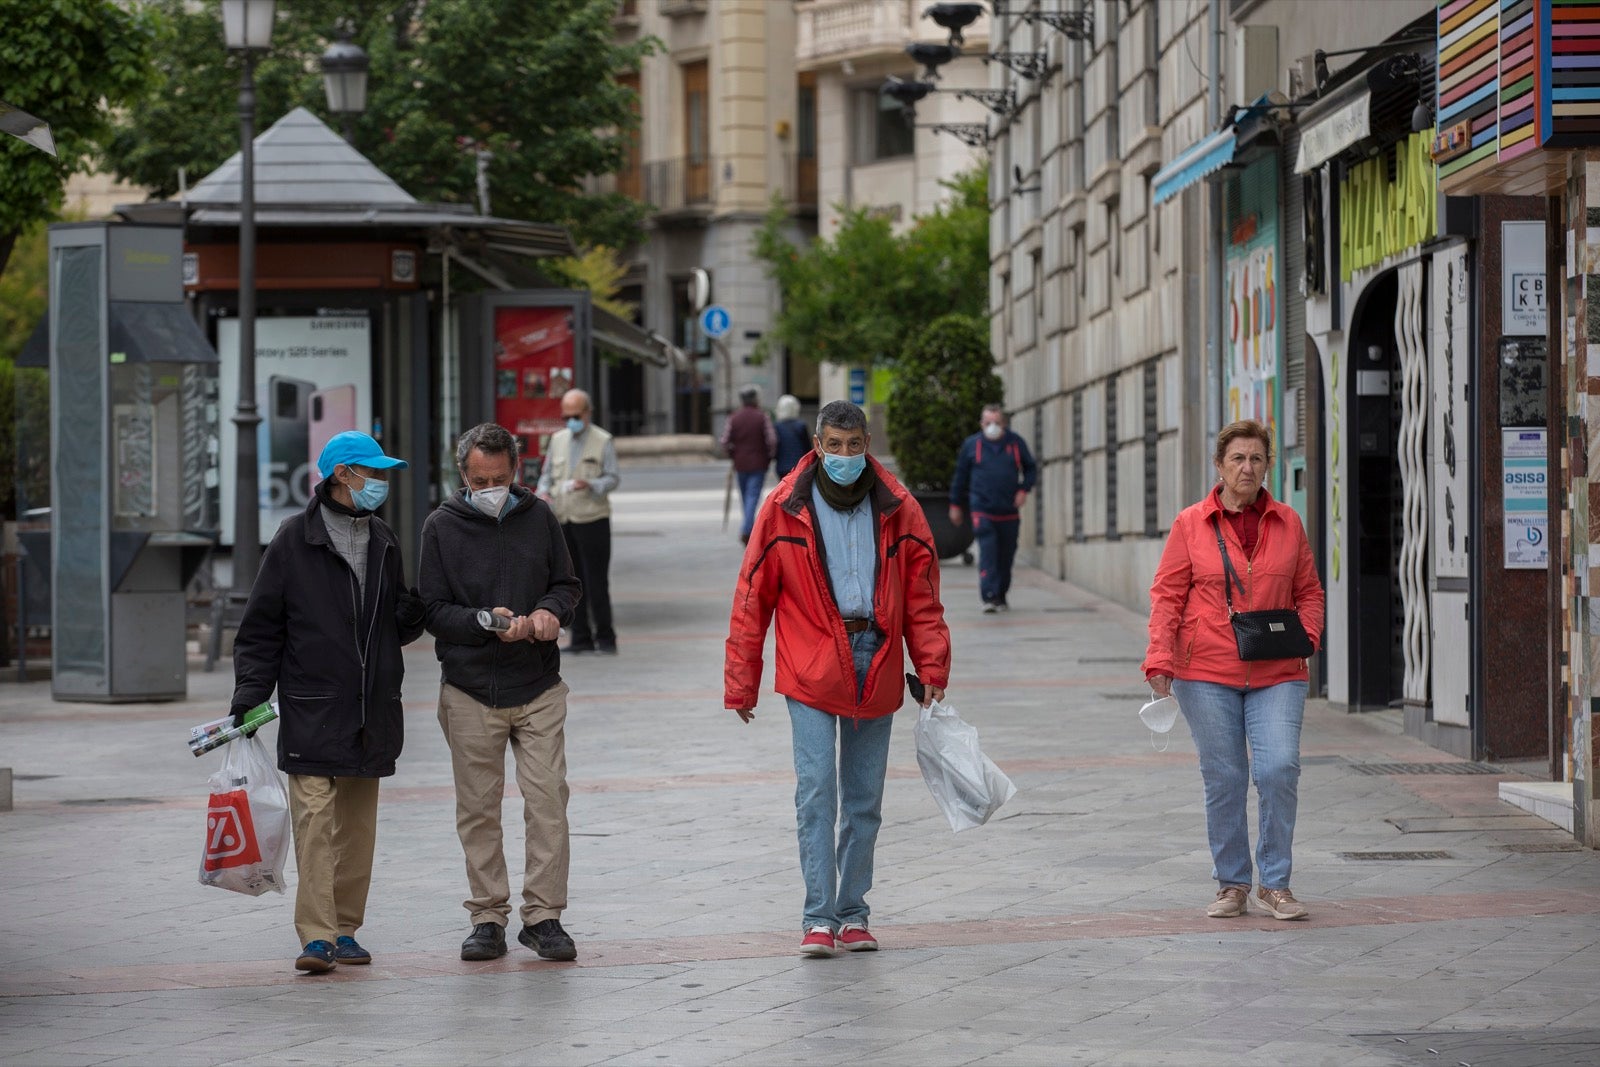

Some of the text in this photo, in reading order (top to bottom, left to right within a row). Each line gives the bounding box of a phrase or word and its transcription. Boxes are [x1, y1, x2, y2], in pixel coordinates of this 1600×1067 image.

[1396, 122, 1438, 251] PAST
[310, 319, 367, 331] SAMSUNG
[254, 345, 286, 361] alaxy
[311, 344, 348, 358] Series
[1505, 472, 1545, 484] asisa
